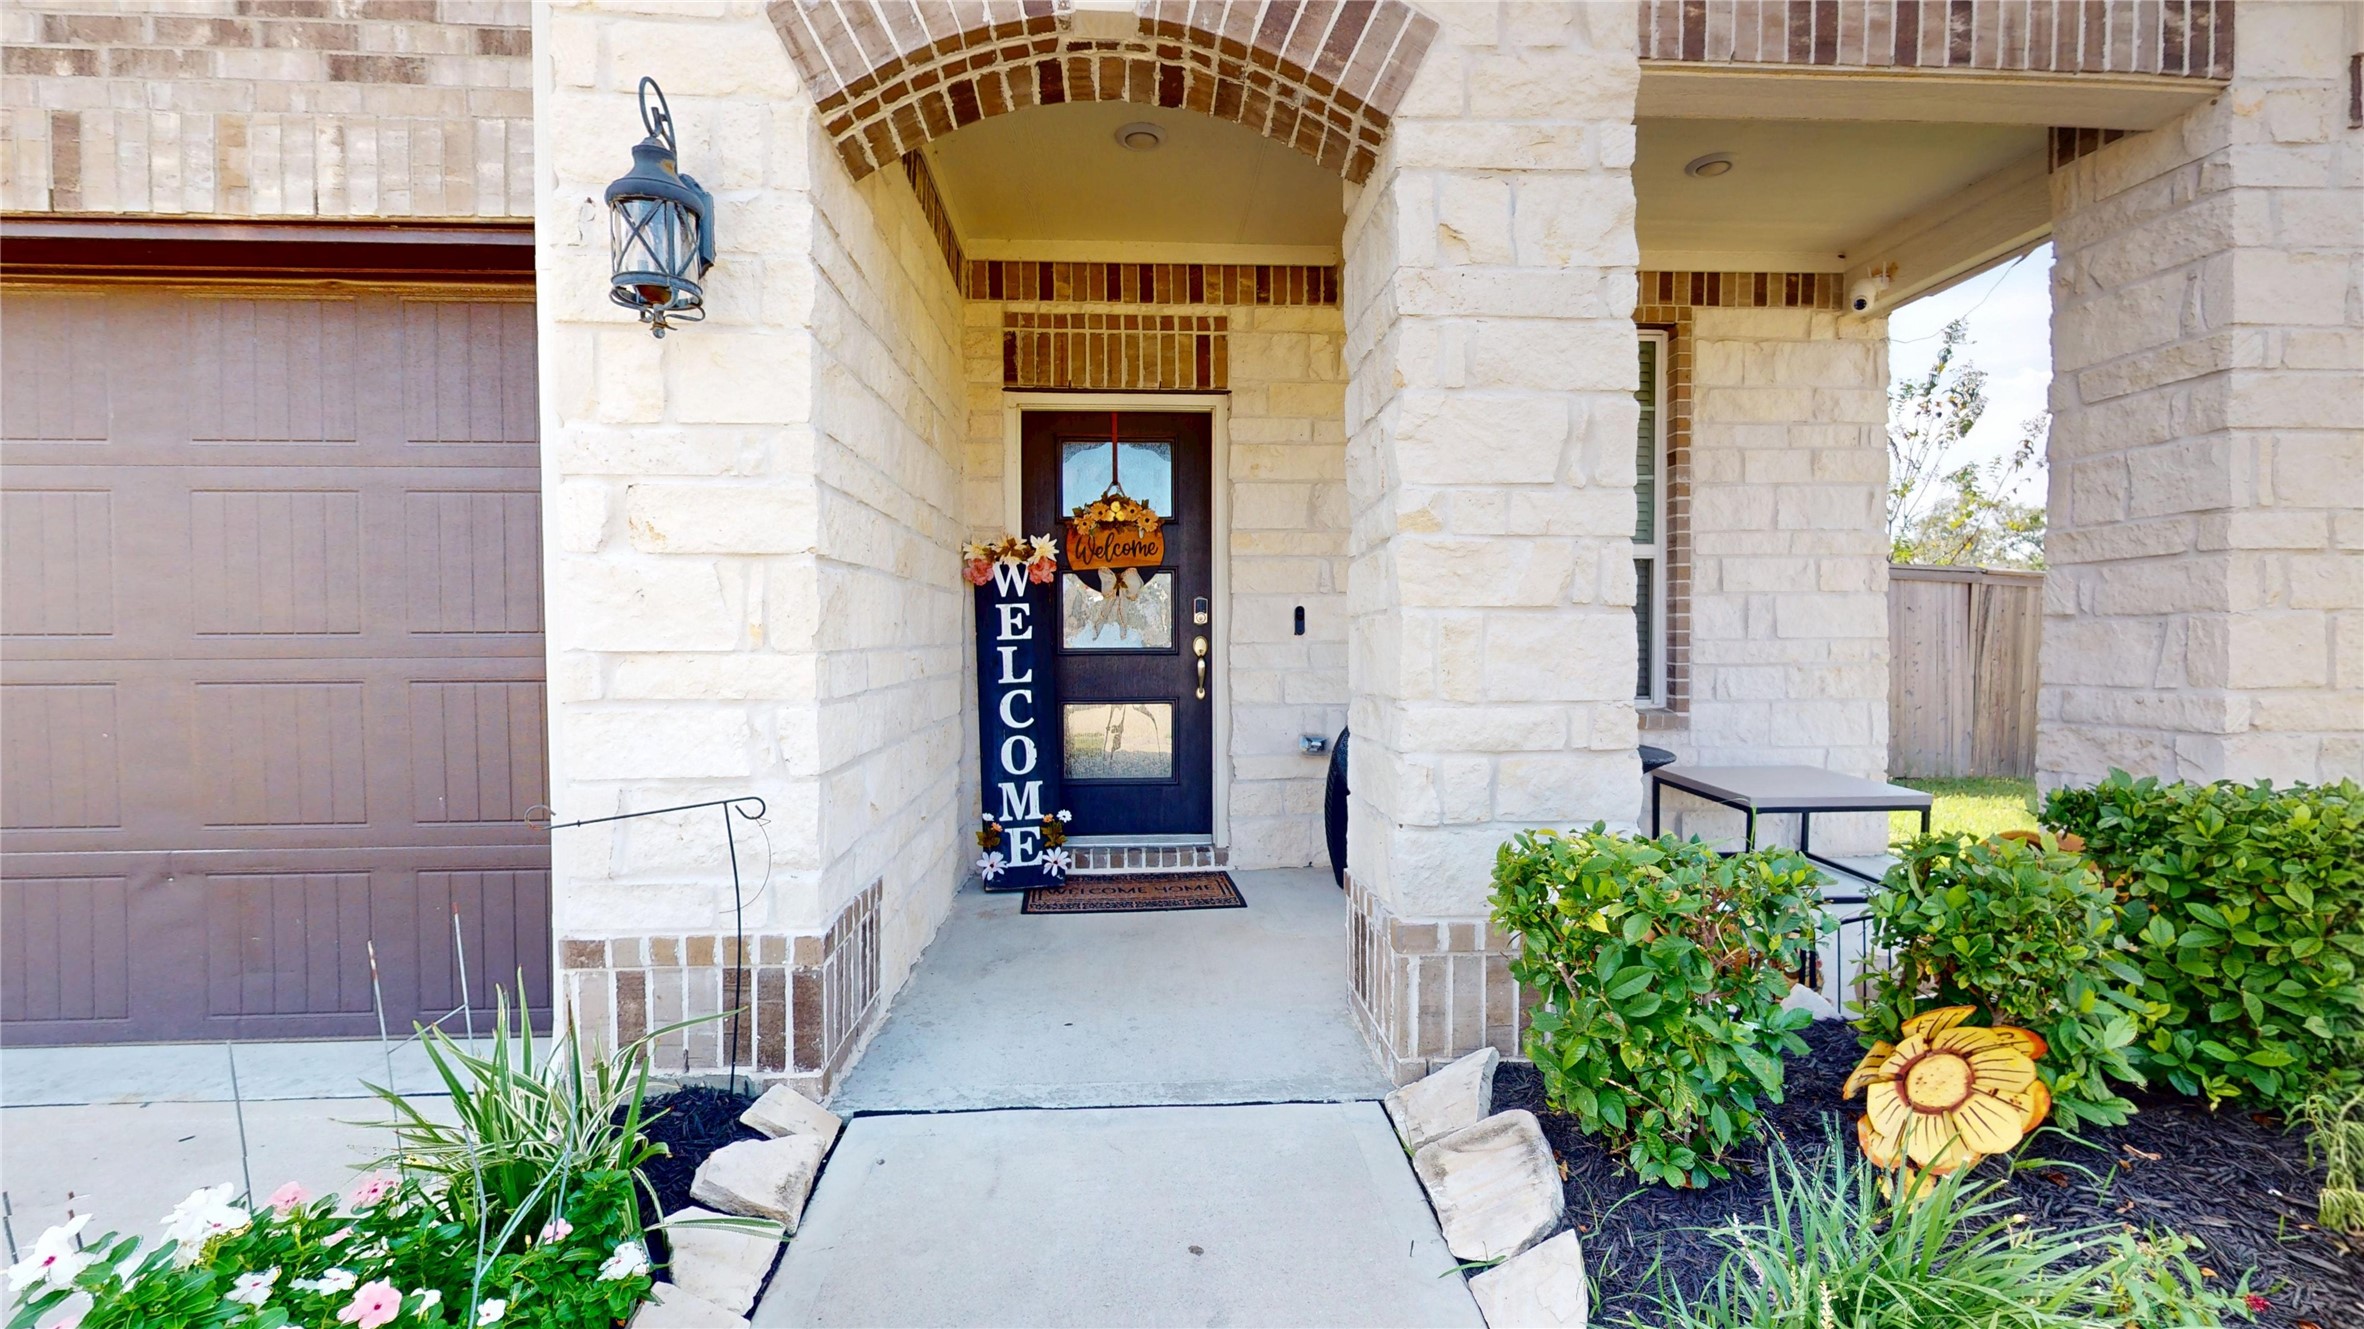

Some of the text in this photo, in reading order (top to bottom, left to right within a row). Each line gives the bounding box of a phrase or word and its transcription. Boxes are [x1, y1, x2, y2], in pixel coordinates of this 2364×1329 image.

[1075, 532, 1159, 565] Welcome
[993, 561, 1044, 868] WELCOME
[1154, 884, 1215, 893] HOME
